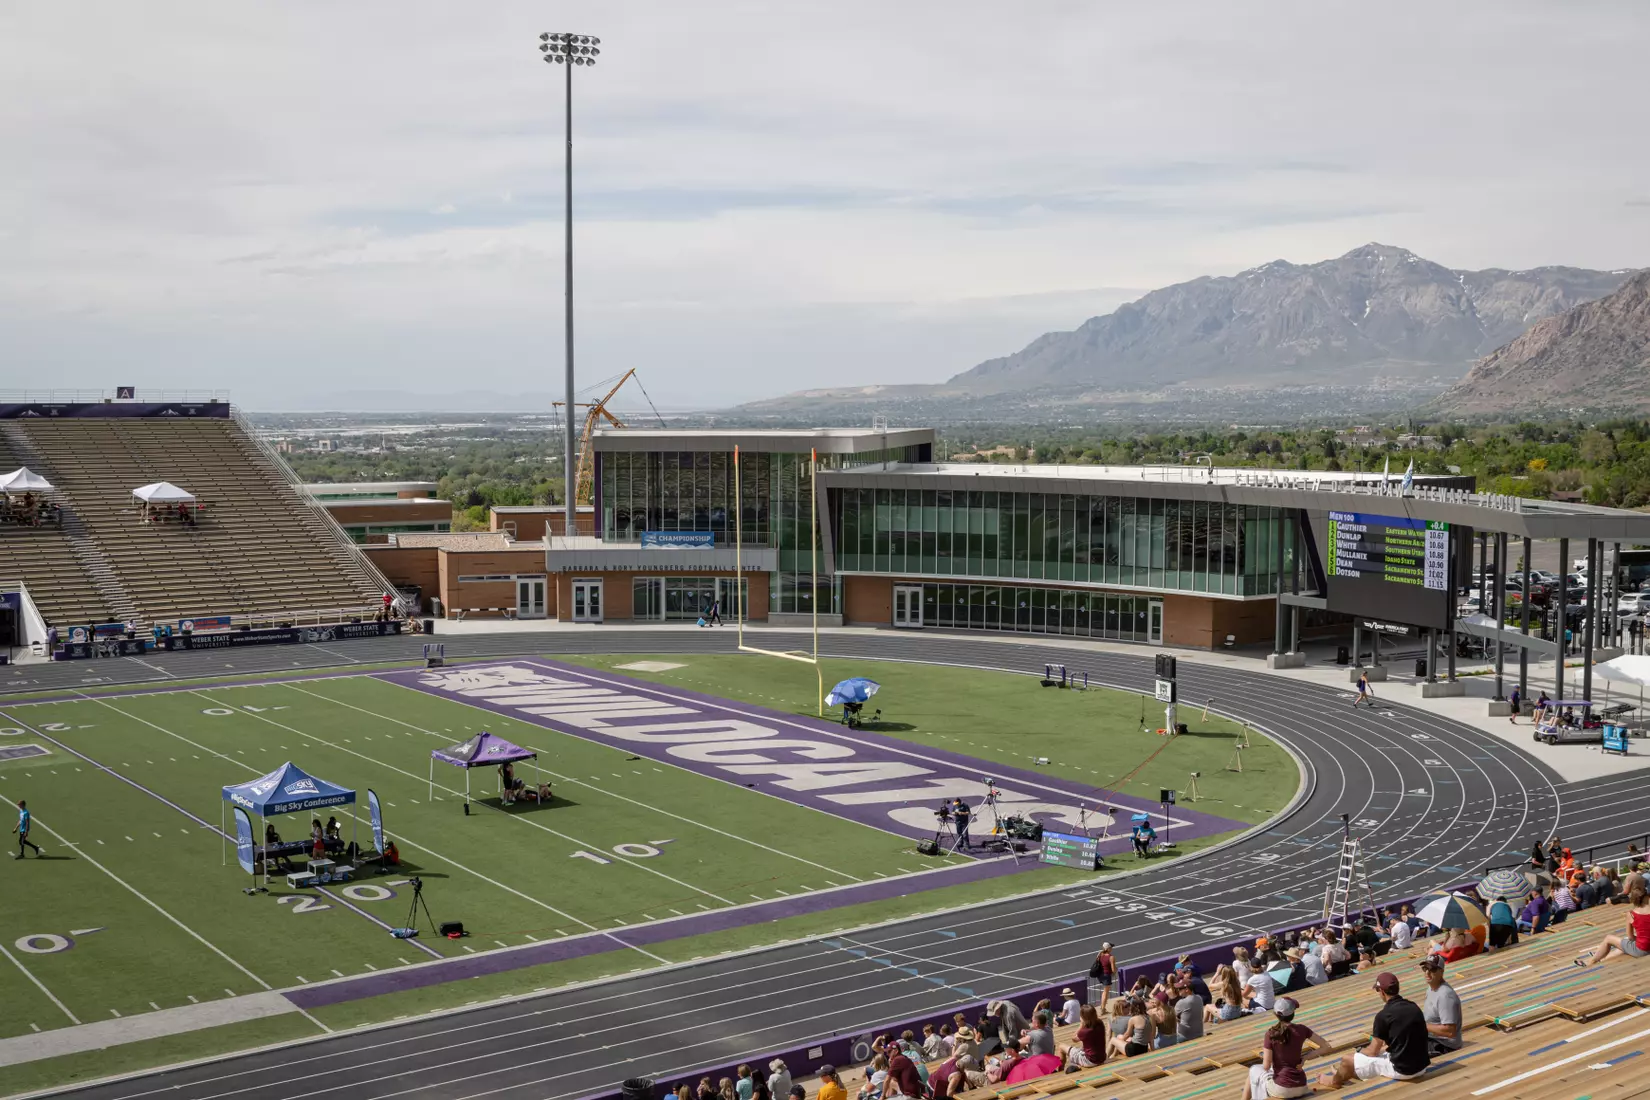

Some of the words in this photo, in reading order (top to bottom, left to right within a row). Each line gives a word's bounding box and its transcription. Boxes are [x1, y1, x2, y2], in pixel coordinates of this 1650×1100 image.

[121, 388, 130, 399] A
[1235, 474, 1322, 491] ELIZABETH
[1414, 486, 1470, 504] STEWART
[1344, 514, 1354, 522] 100
[1336, 530, 1362, 540] DUNLAP
[1430, 541, 1444, 550] 10.68
[1430, 532, 1444, 540] 10.67
[1336, 540, 1357, 550] WHITE
[1430, 551, 1444, 559] 10.88
[1384, 564, 1417, 575] SACRAMENTO
[1401, 558, 1416, 566] STATE
[1428, 560, 1444, 569] 10.90
[1336, 567, 1360, 578] DOTSON
[1384, 574, 1416, 584] SACRAMENTO
[1428, 580, 1444, 588] 11.15
[456, 683, 1116, 836] WILDCATS
[304, 796, 346, 807] Conference
[1062, 889, 1093, 899] 1
[1086, 896, 1122, 906] 2
[1114, 903, 1148, 912] 3
[1144, 911, 1177, 920] 4
[1170, 917, 1206, 928] 5
[1200, 926, 1234, 936] 6
